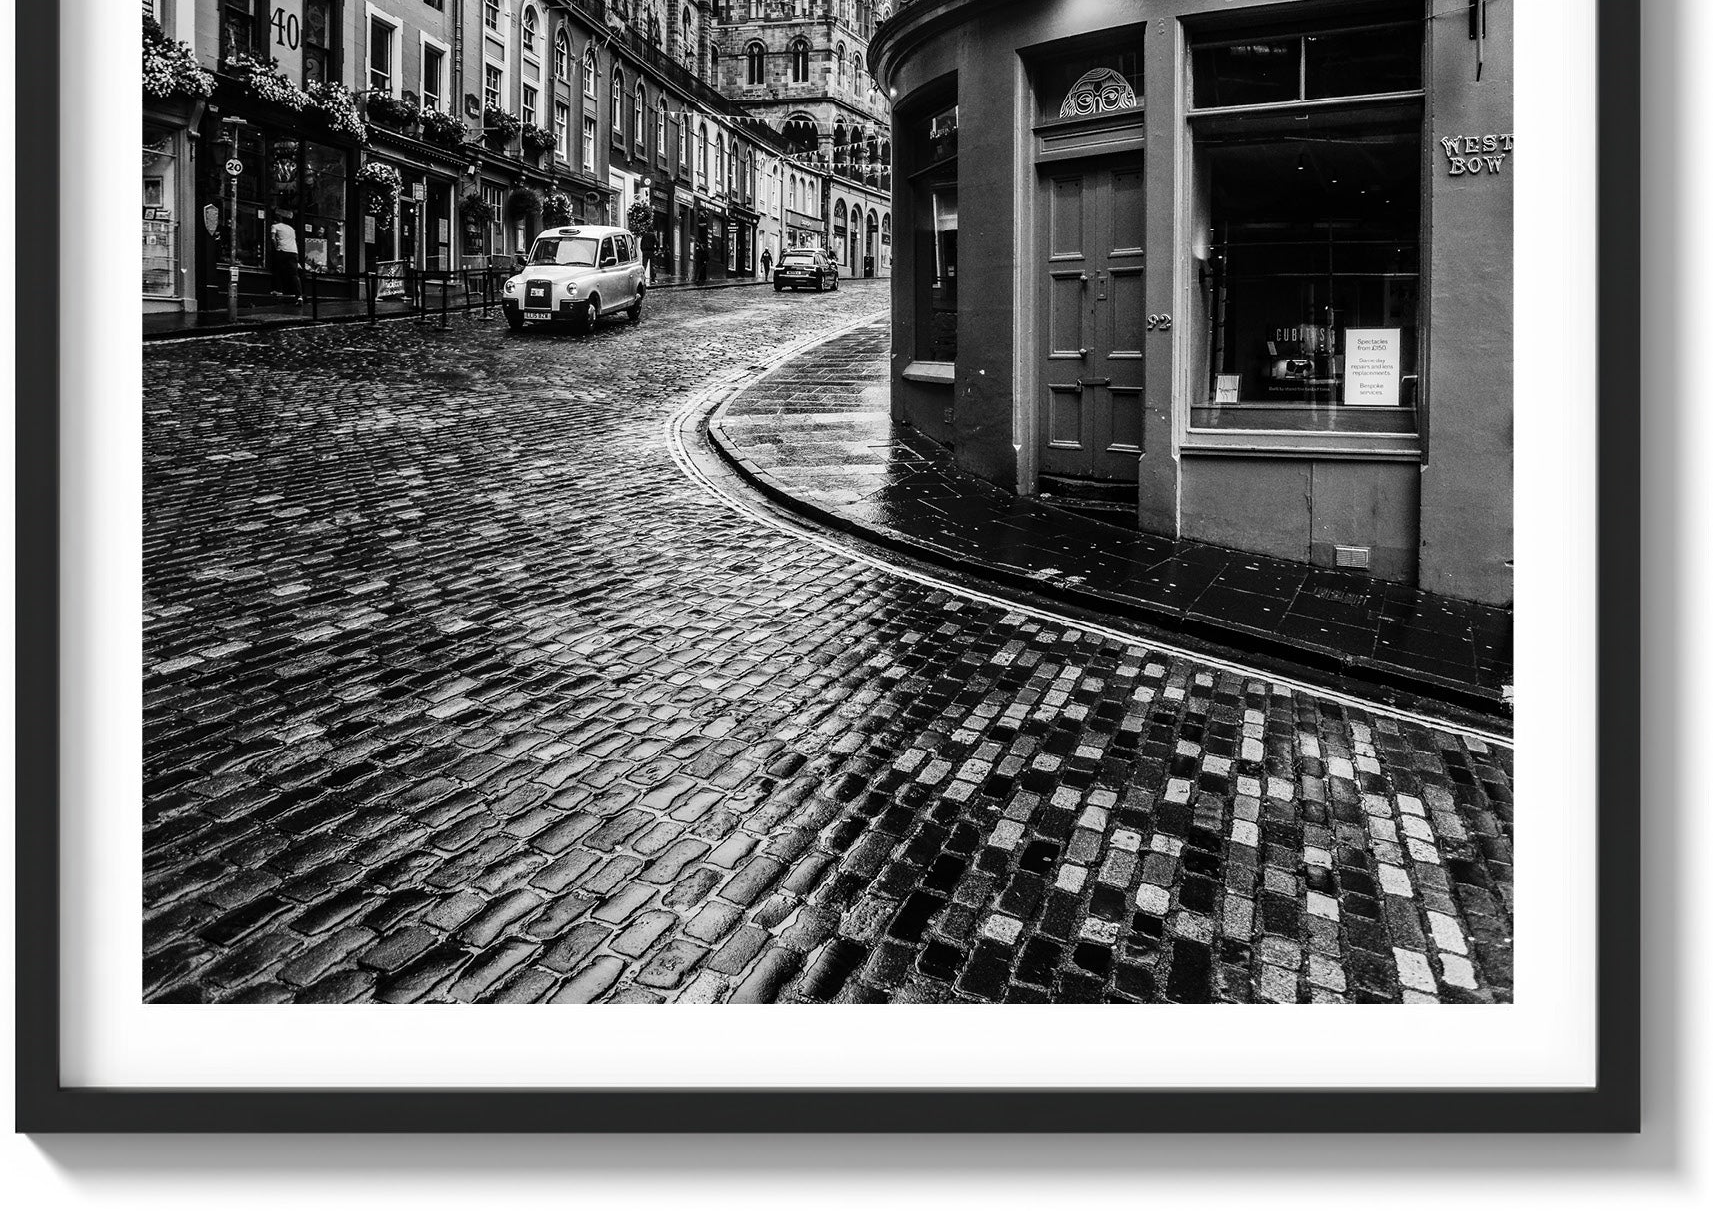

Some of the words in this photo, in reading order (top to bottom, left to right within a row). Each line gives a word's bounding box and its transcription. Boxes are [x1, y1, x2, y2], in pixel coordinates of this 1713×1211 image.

[271, 7, 300, 51] 40
[1440, 133, 1514, 157] WEST
[227, 161, 242, 173] 20
[1449, 153, 1506, 175] BOW
[1147, 313, 1172, 331] 92
[1357, 338, 1388, 346] Spectacles
